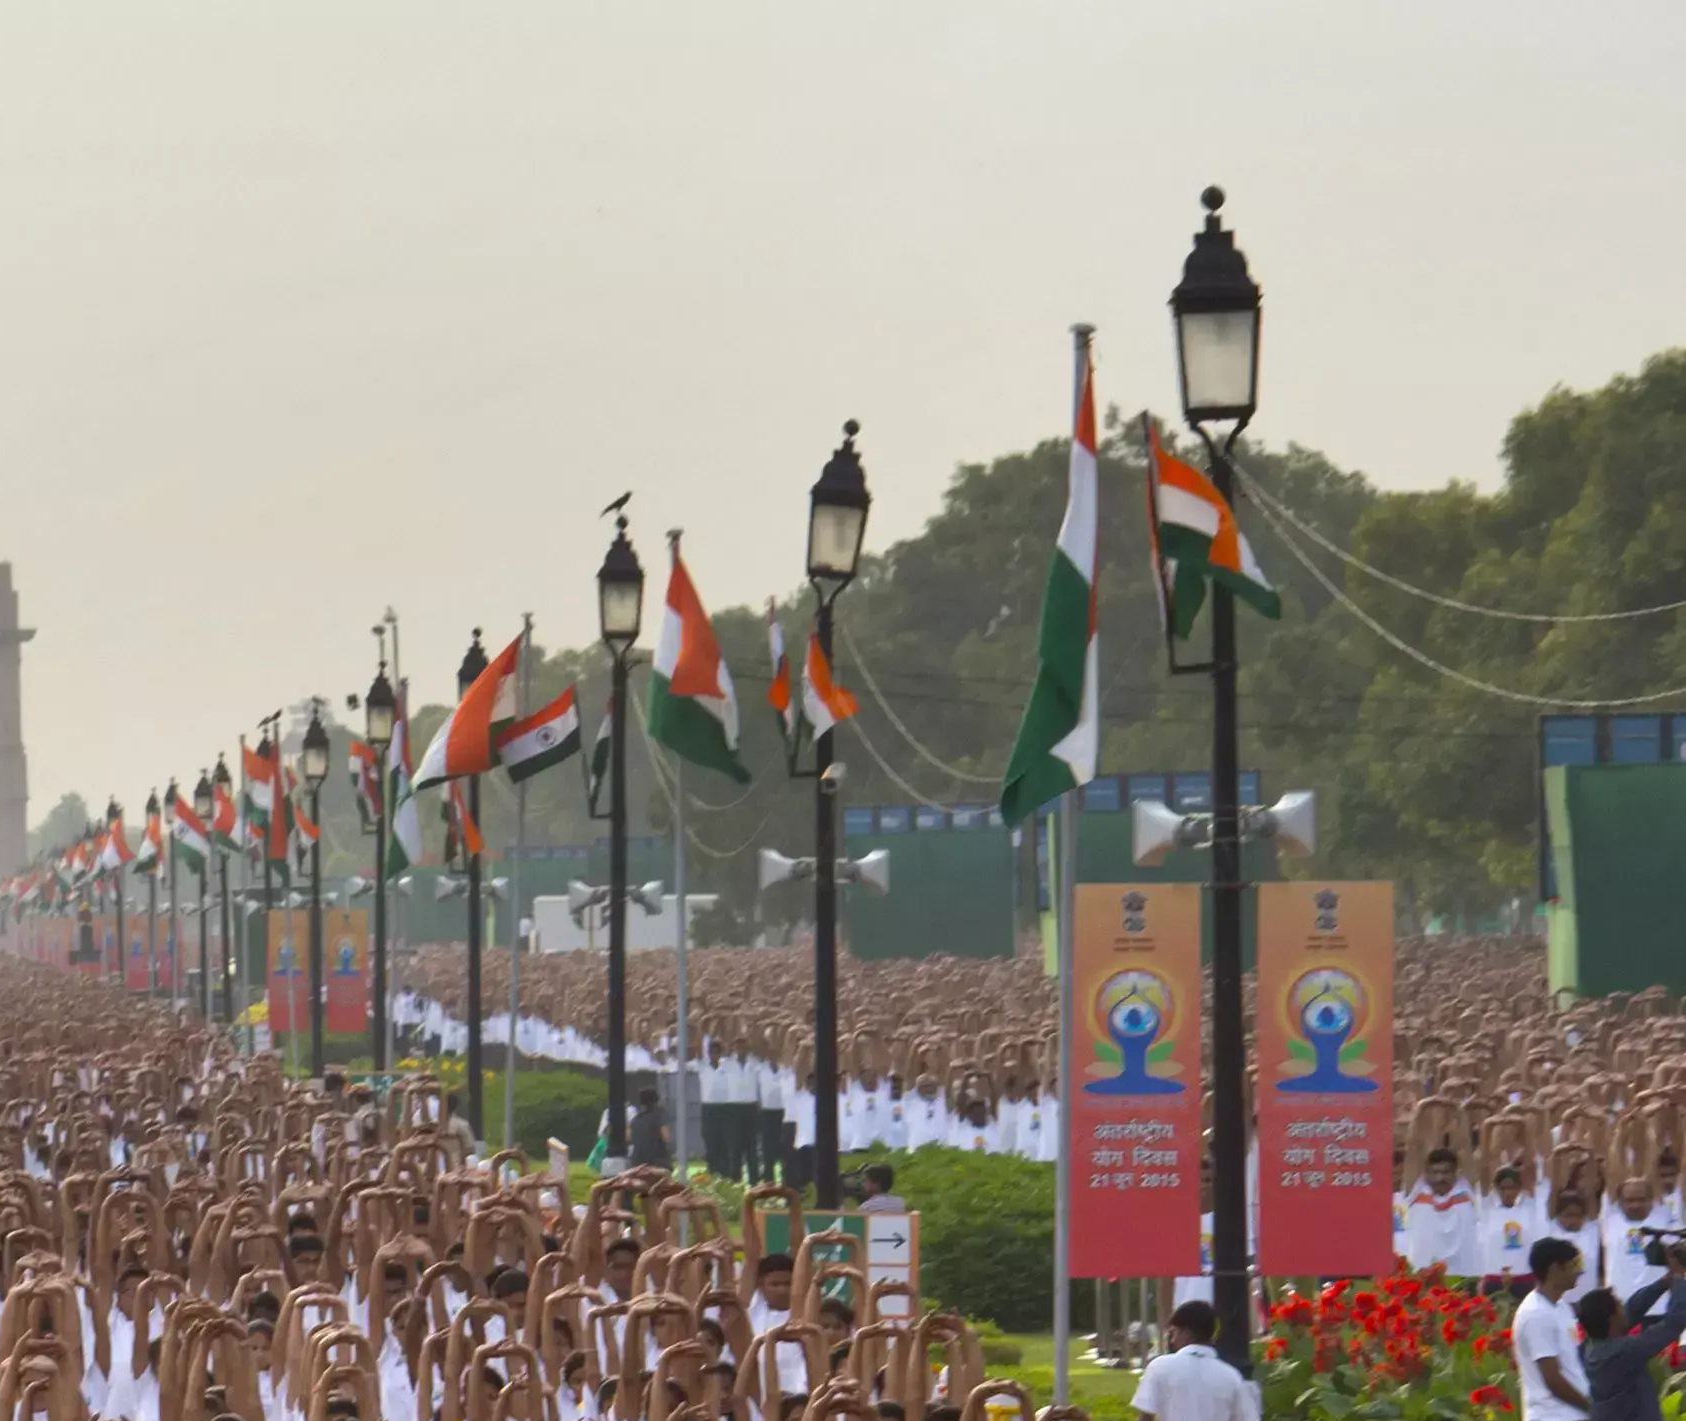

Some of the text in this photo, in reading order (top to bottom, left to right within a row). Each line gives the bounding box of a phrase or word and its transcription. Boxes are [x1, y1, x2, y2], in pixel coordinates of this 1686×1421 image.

[1090, 1145, 1179, 1168] योग दिवस
[1282, 1143, 1369, 1166] योग दिवस
[1089, 1172, 1109, 1188] 21
[1139, 1172, 1181, 1188] 2015
[1280, 1171, 1300, 1188] 21
[1331, 1171, 1372, 1188] 2015
